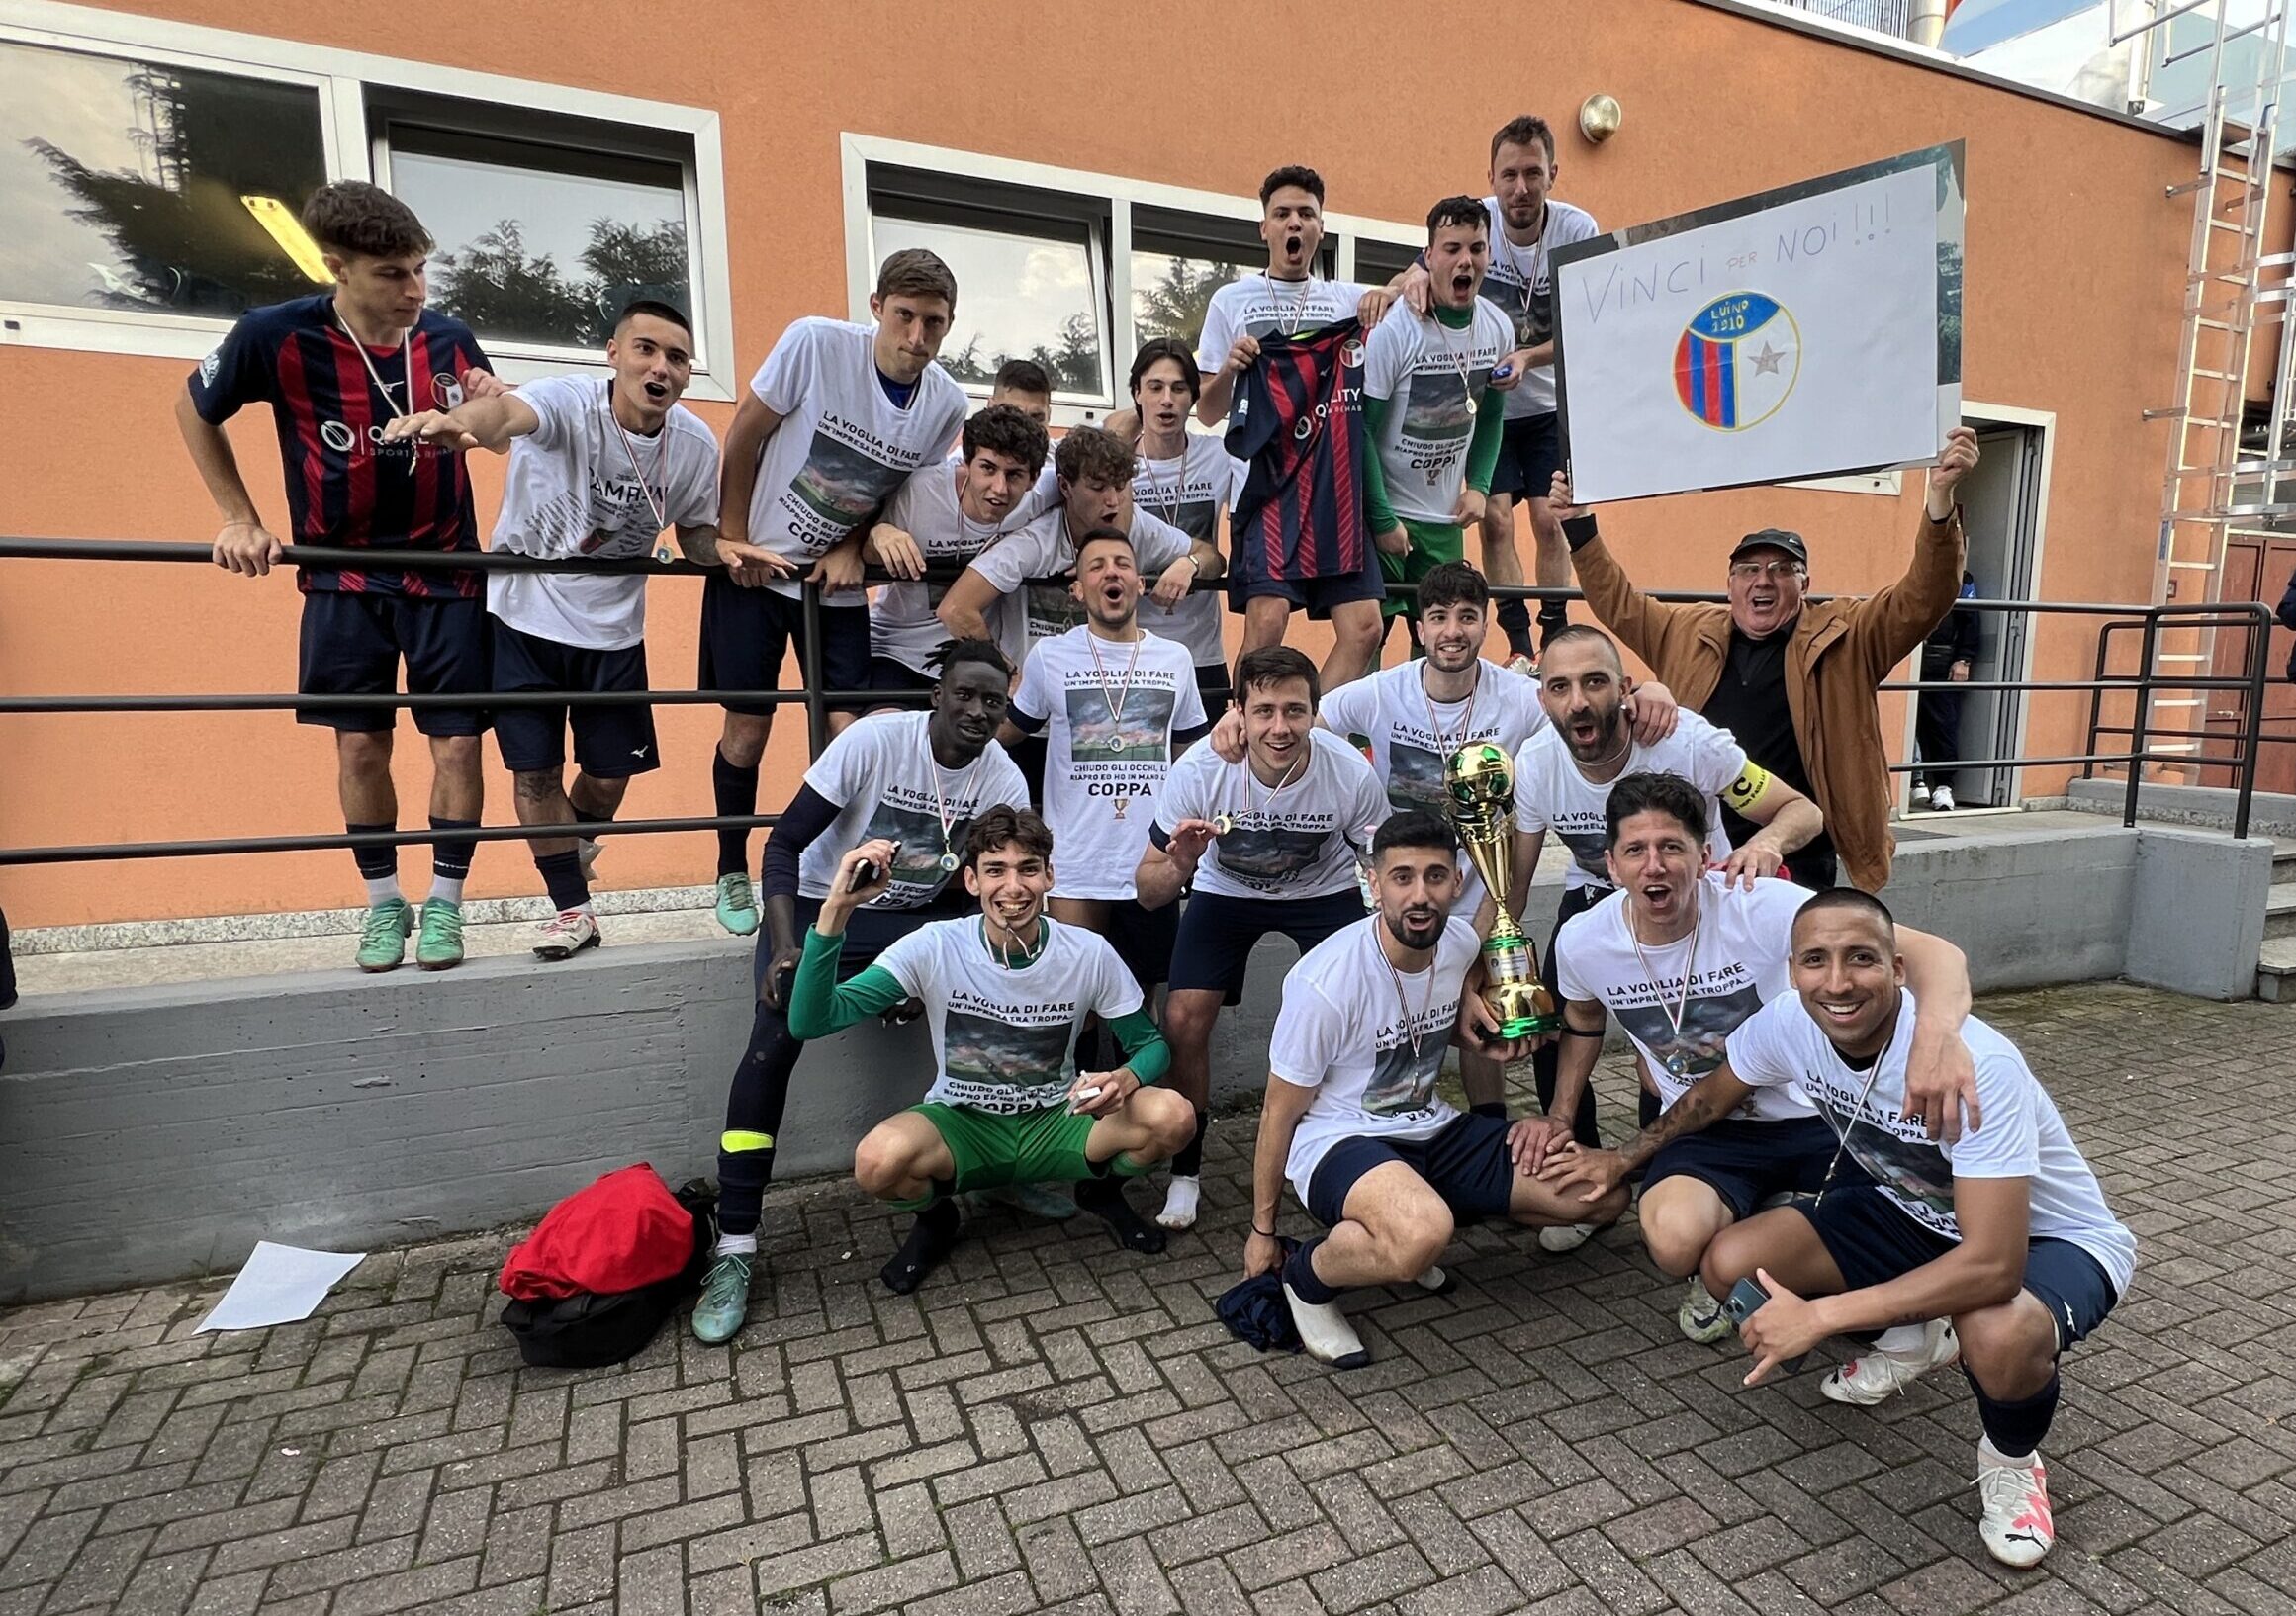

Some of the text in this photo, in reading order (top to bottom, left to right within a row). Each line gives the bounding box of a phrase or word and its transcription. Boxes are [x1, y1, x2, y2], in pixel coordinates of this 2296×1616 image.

[1725, 251, 1759, 272] PER
[1711, 314, 1745, 333] 1910
[823, 410, 838, 425] LA
[842, 419, 883, 449] VOGLIA
[887, 445, 899, 456] DI
[1402, 438, 1433, 450] CHIUDO
[1188, 482, 1213, 492] FARE
[787, 494, 820, 524] CHIUDO
[929, 539, 943, 548] LA
[1065, 671, 1081, 679] LA
[1084, 670, 1129, 678] VOGLIA
[1149, 671, 1175, 680] FARE
[1393, 721, 1408, 732] LA
[1471, 727, 1501, 740] FARE
[888, 783, 898, 794] LA
[944, 798, 956, 807] DI
[1088, 783, 1152, 796] COPPA
[1732, 776, 1752, 796] C
[1552, 811, 1607, 822] LA VOGLI
[1607, 962, 1745, 996] LA VOGLIA DI FARE
[952, 990, 968, 1001] LA
[1024, 1005, 1037, 1014] DI
[1042, 1002, 1075, 1013] FARE
[1376, 1026, 1394, 1038] LA
[1430, 1008, 1440, 1018] DI
[944, 1089, 980, 1101] RIAPRO
[949, 1082, 993, 1093] CHIUDO
